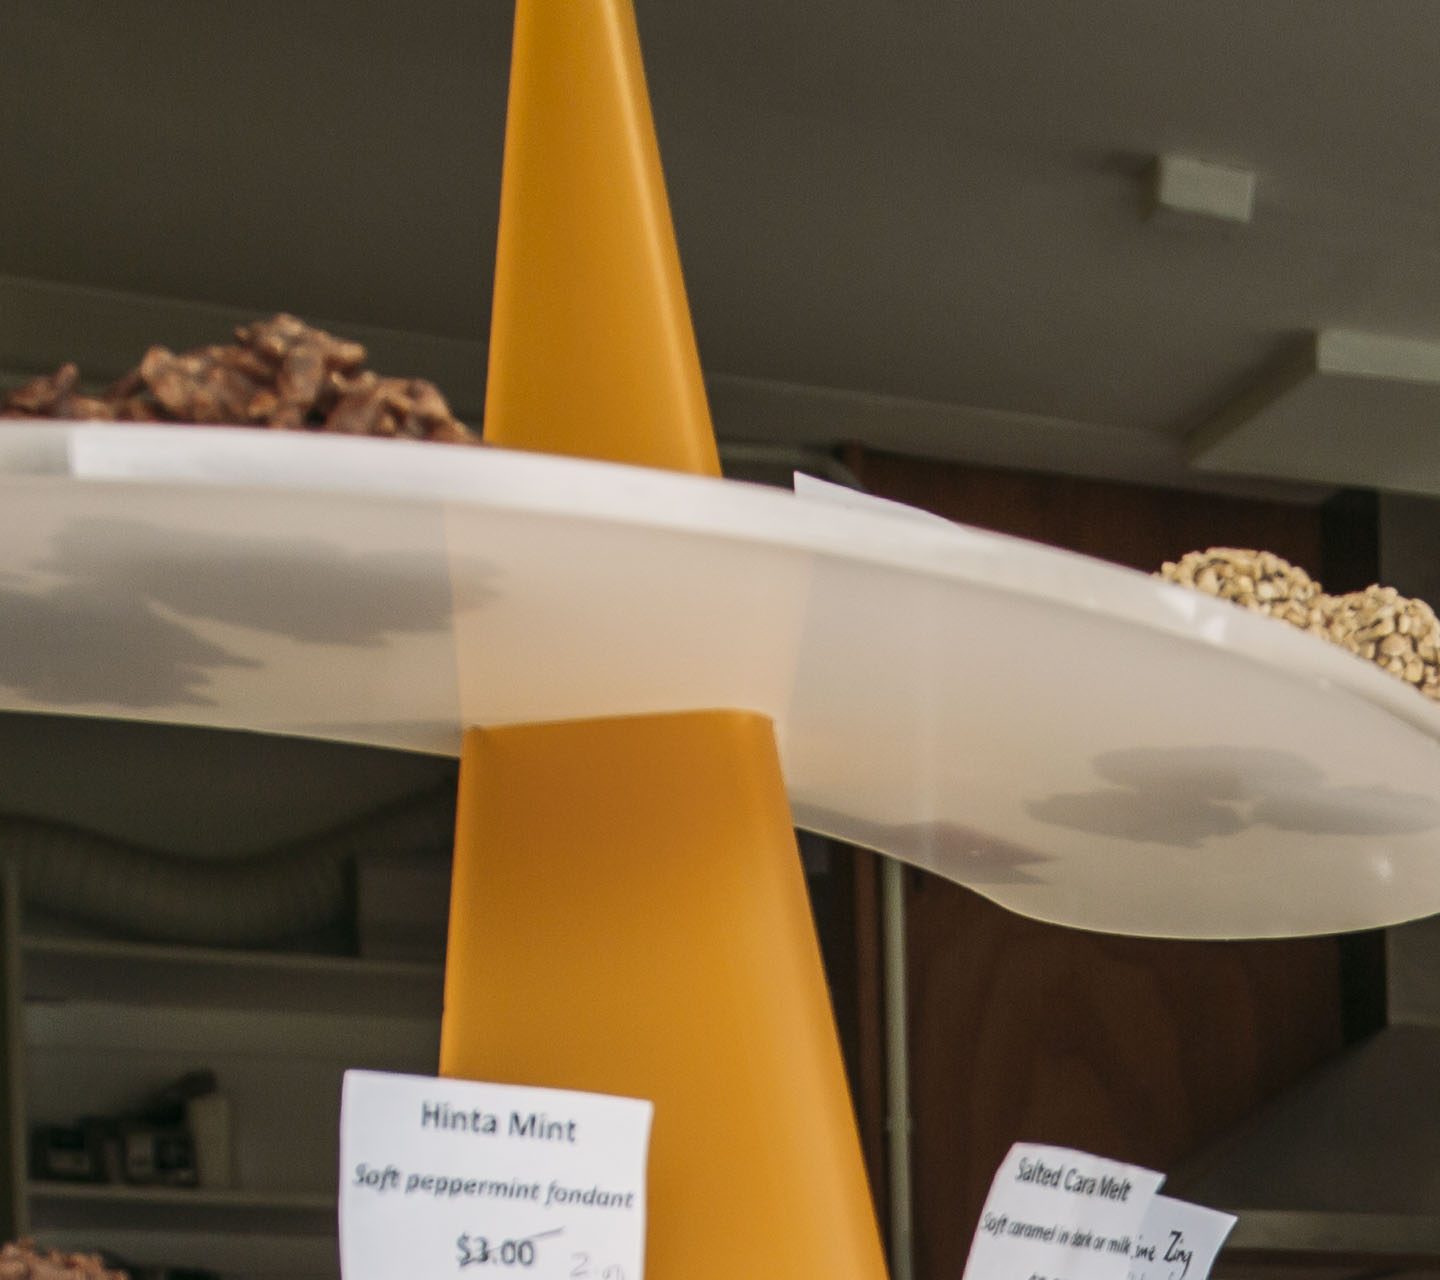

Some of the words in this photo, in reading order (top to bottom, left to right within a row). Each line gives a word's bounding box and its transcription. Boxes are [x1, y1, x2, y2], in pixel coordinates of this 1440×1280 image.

[420, 1100, 498, 1135] Hinta
[508, 1111, 577, 1143] Mint
[354, 1163, 401, 1189] Soft
[405, 1173, 540, 1201] peppermint
[544, 1181, 634, 1209] fondant
[1015, 1157, 1061, 1187] Salted
[1064, 1168, 1096, 1196] Cara
[1099, 1178, 1132, 1202] Melt
[1008, 1220, 1056, 1241] caramel
